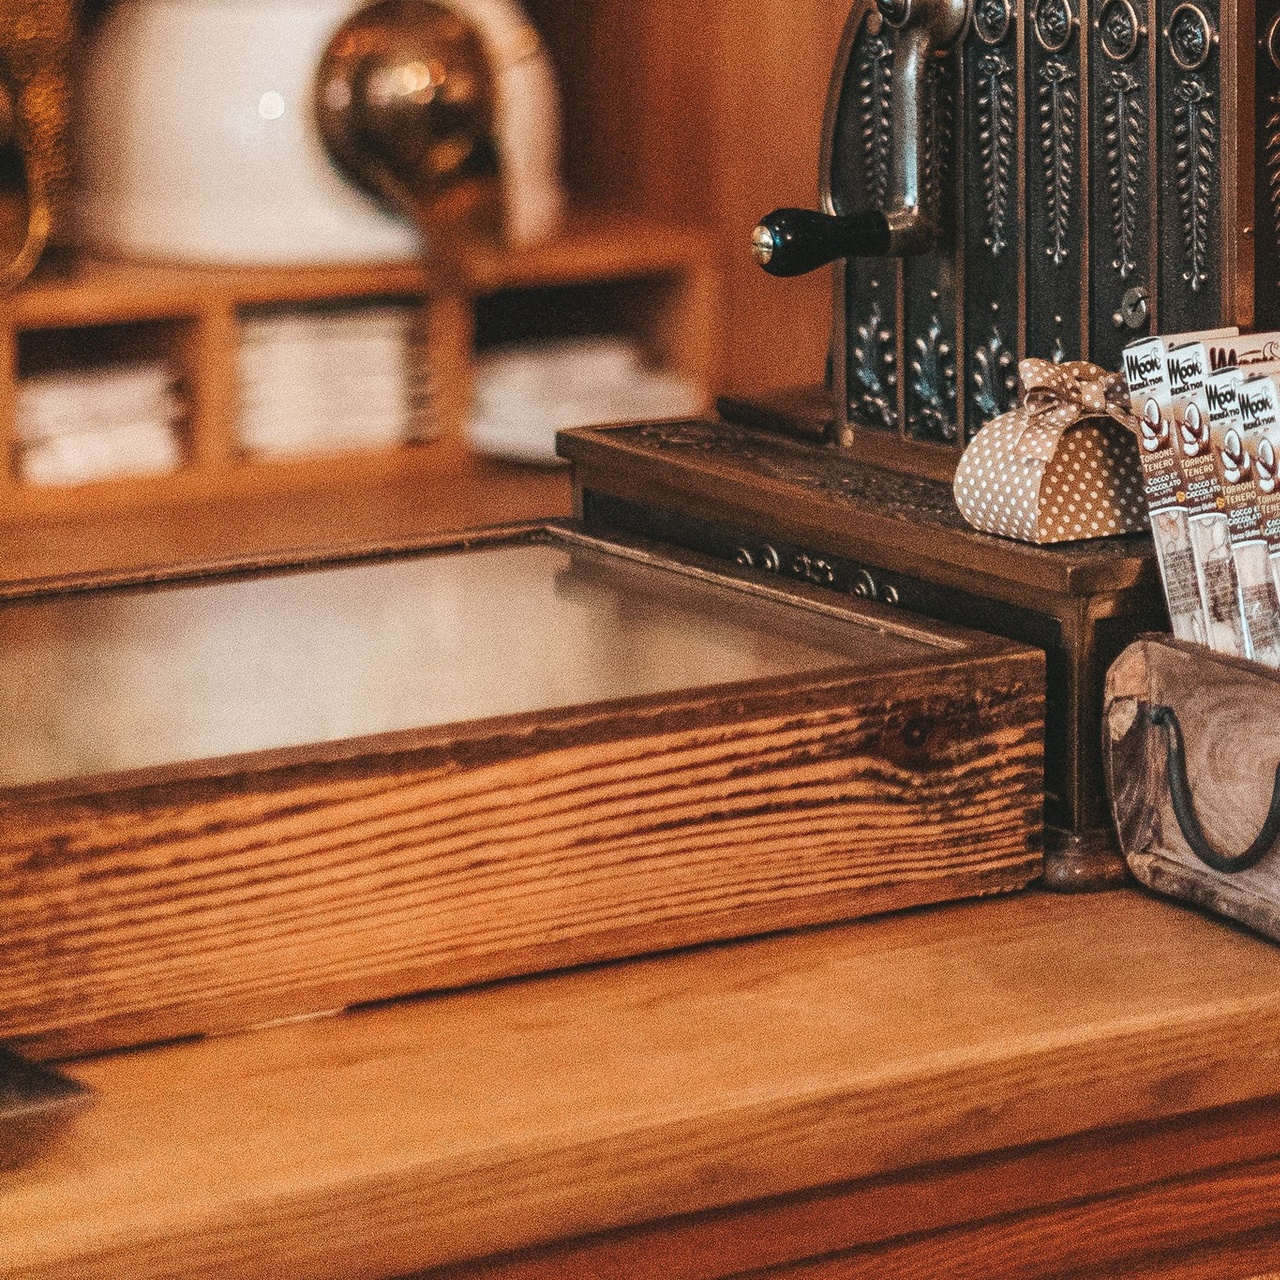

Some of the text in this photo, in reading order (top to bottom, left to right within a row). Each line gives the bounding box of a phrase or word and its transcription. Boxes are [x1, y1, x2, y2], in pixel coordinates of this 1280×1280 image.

[1125, 351, 1162, 383] Moon
[1166, 355, 1203, 386] Moon
[1237, 389, 1274, 421] Moon
[1140, 447, 1175, 465] TORRONE
[1181, 452, 1215, 469] TORRONE
[1144, 459, 1174, 473] TENERO
[1184, 464, 1214, 479] TENERO
[1145, 478, 1182, 494] CIOCCOLATO
[1148, 473, 1170, 486] COCCO
[1188, 479, 1210, 491] COCCO
[1225, 491, 1257, 505] TENERO
